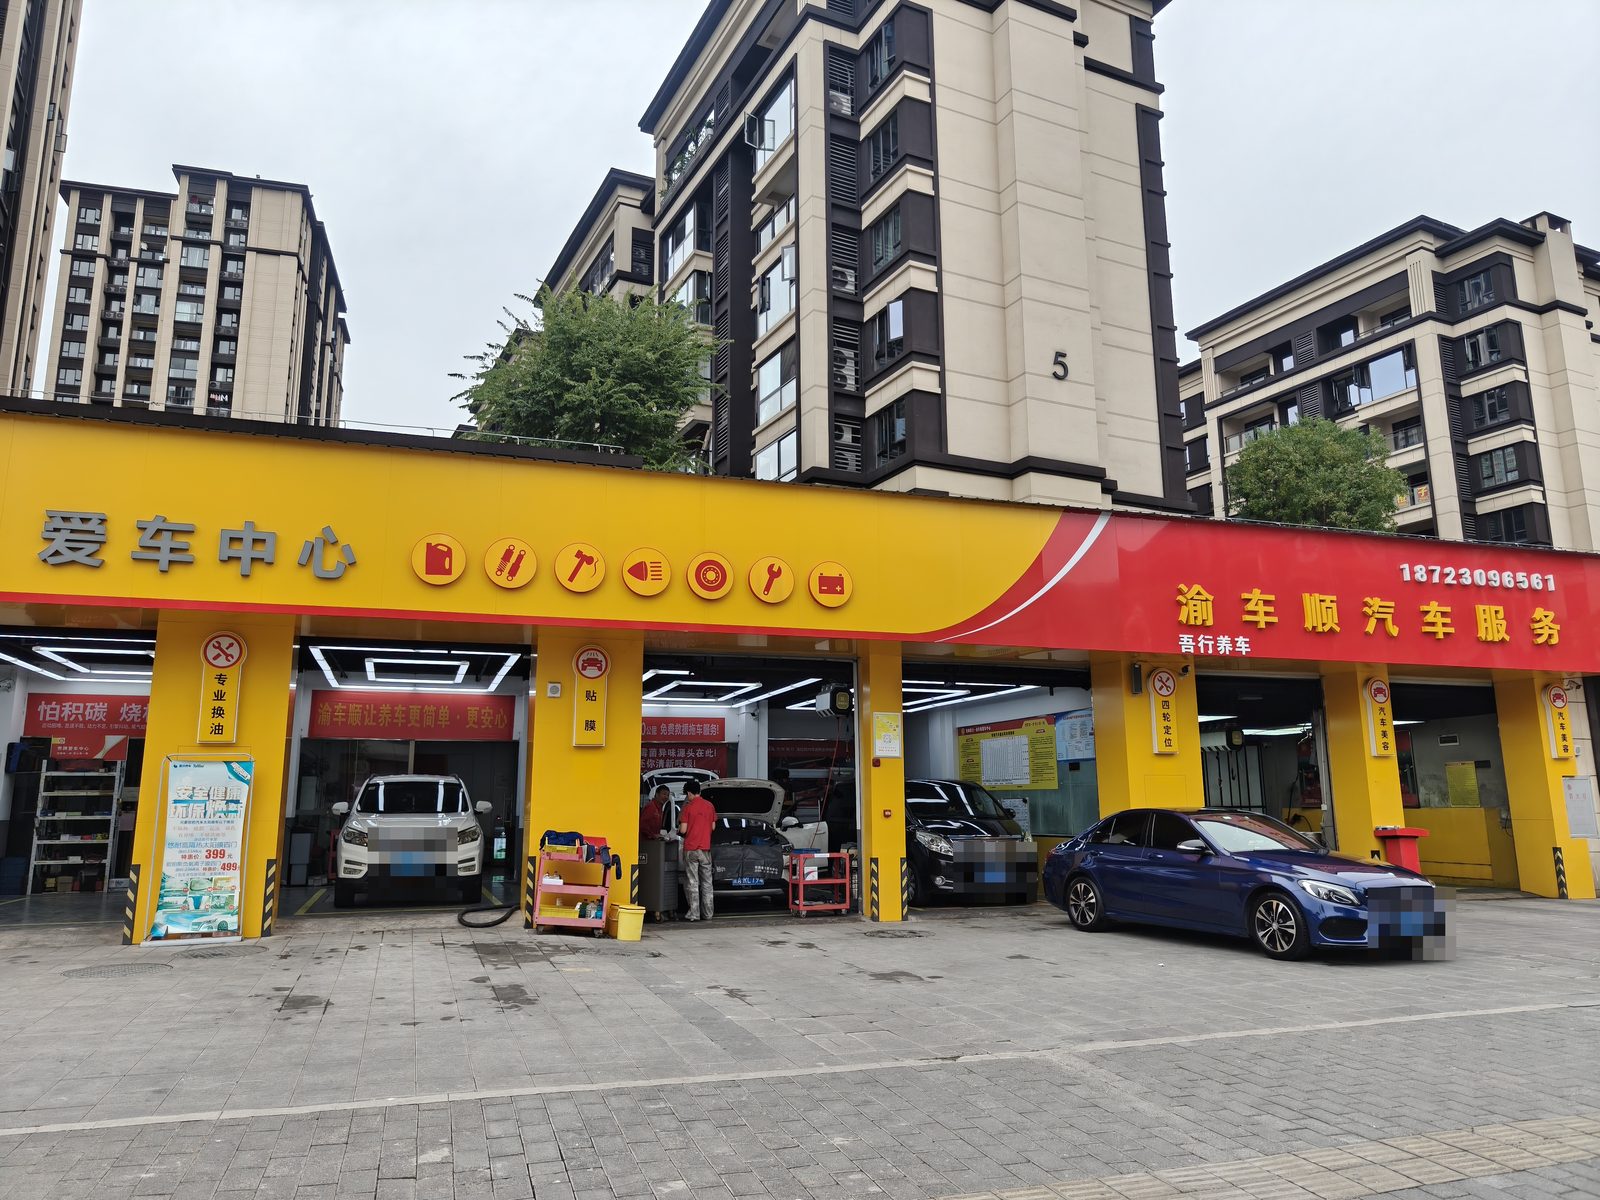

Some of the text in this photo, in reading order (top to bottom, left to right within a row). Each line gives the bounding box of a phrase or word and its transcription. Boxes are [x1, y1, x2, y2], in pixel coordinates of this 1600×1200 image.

[1052, 351, 1069, 380] 5
[38, 509, 356, 580] 爱车中心
[1400, 563, 1556, 592] 18723096561
[1175, 583, 1562, 646] 渝车顺汽车服务
[1178, 634, 1252, 656] 吾行养车
[38, 701, 108, 721] 怕积碳
[209, 673, 228, 735] 专业换油
[584, 690, 598, 731] 贴膜
[1161, 700, 1173, 747] 四轮定位
[1378, 706, 1390, 751] 汽车美容
[1557, 711, 1570, 753] 汽车美容
[205, 848, 226, 860] 399
[220, 862, 238, 871] 499
